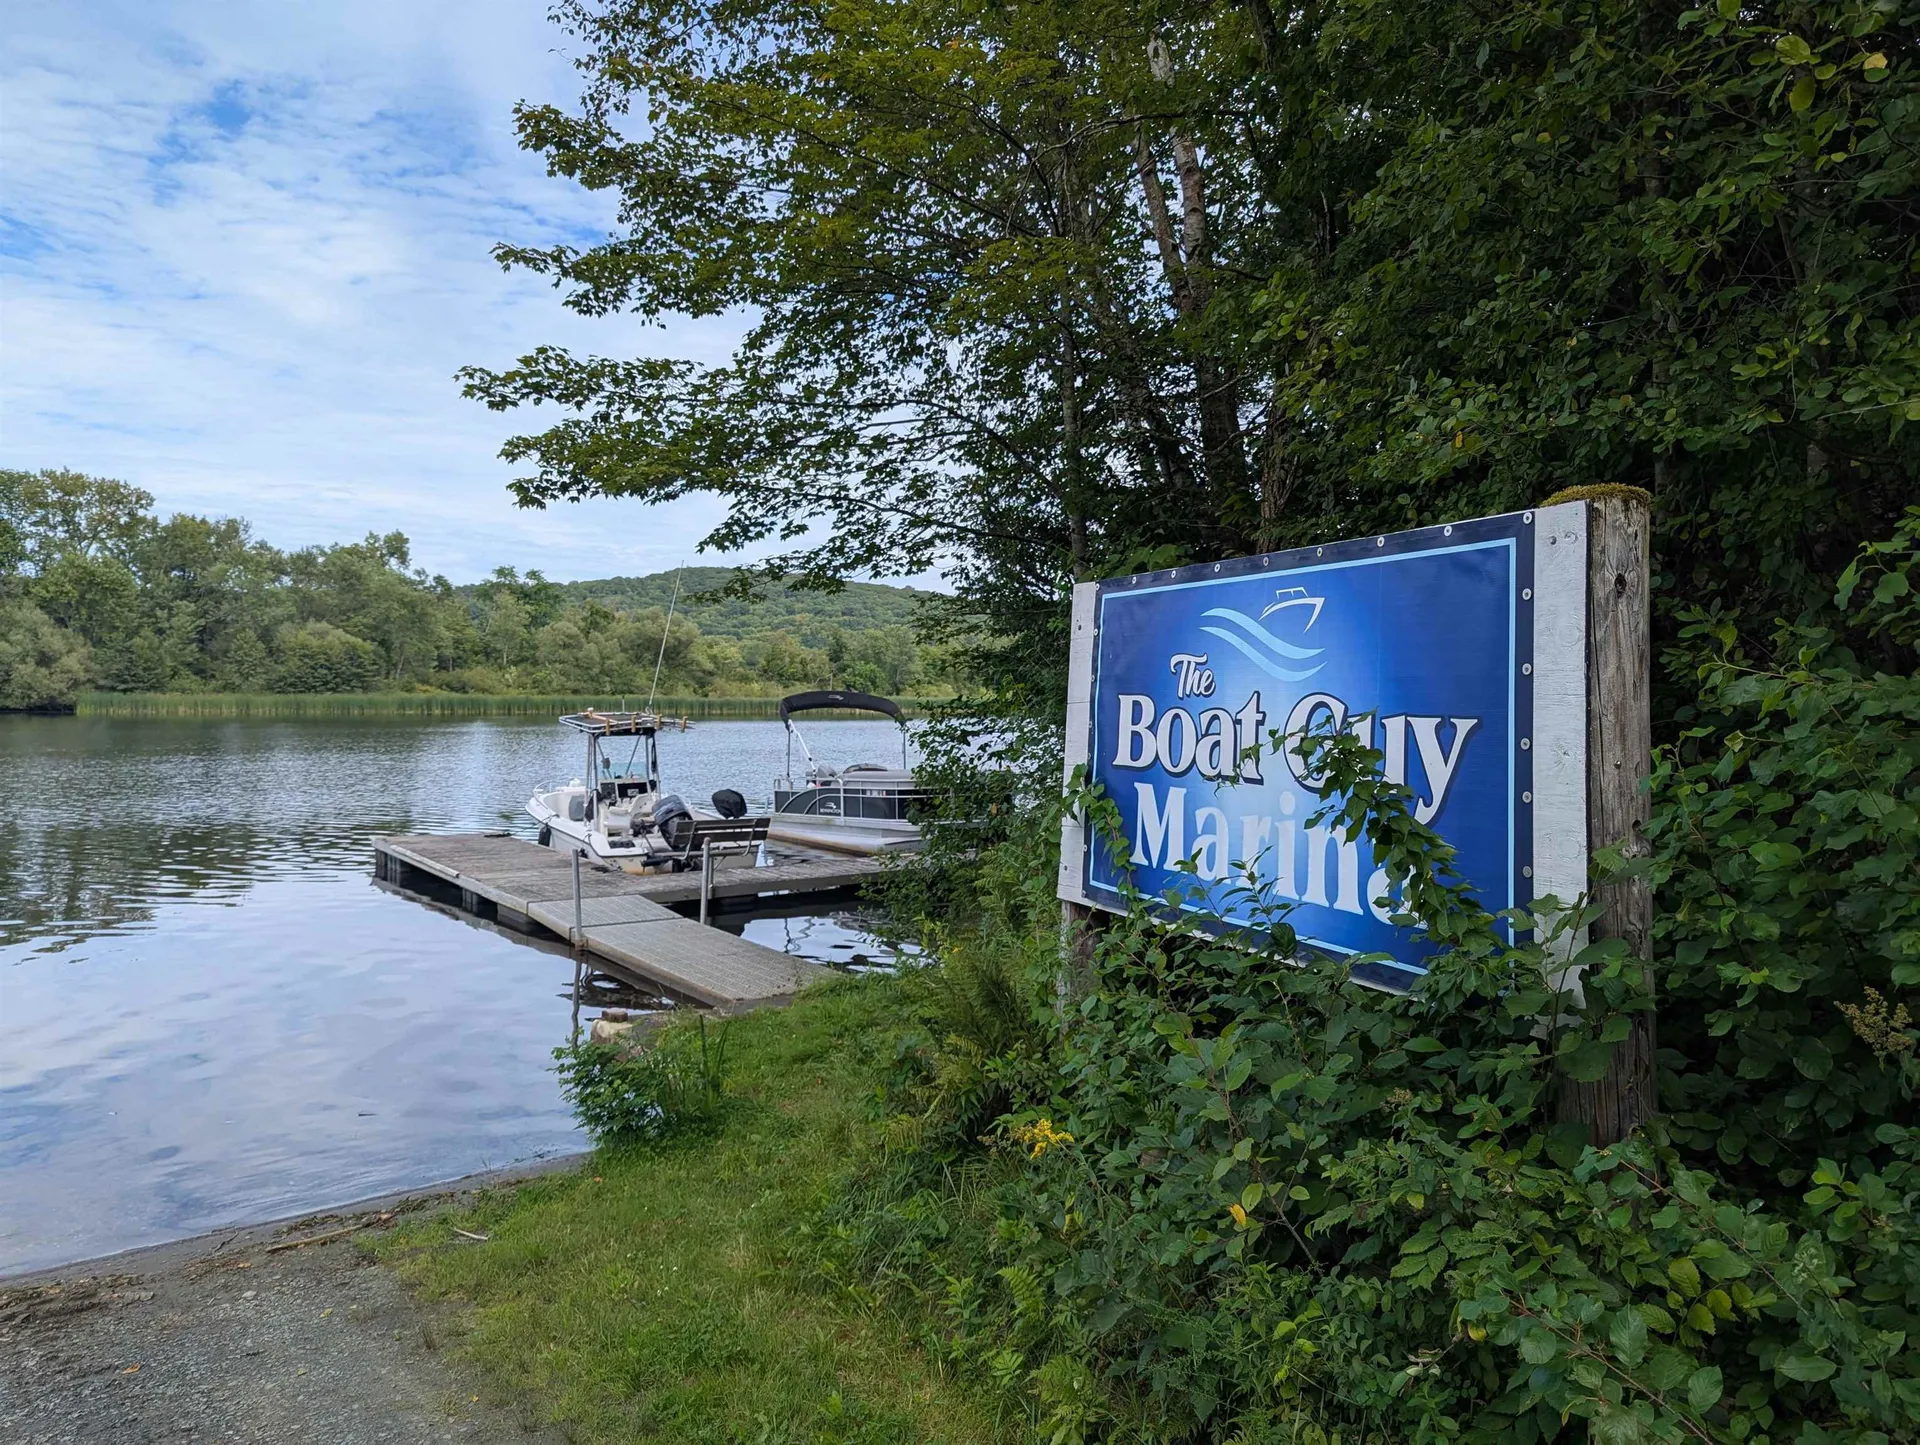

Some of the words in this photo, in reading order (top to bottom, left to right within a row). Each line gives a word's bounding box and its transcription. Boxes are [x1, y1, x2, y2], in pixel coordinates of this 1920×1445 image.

[1170, 653, 1216, 698] The
[1112, 691, 1265, 786] Boat
[1283, 692, 1479, 826] Guy
